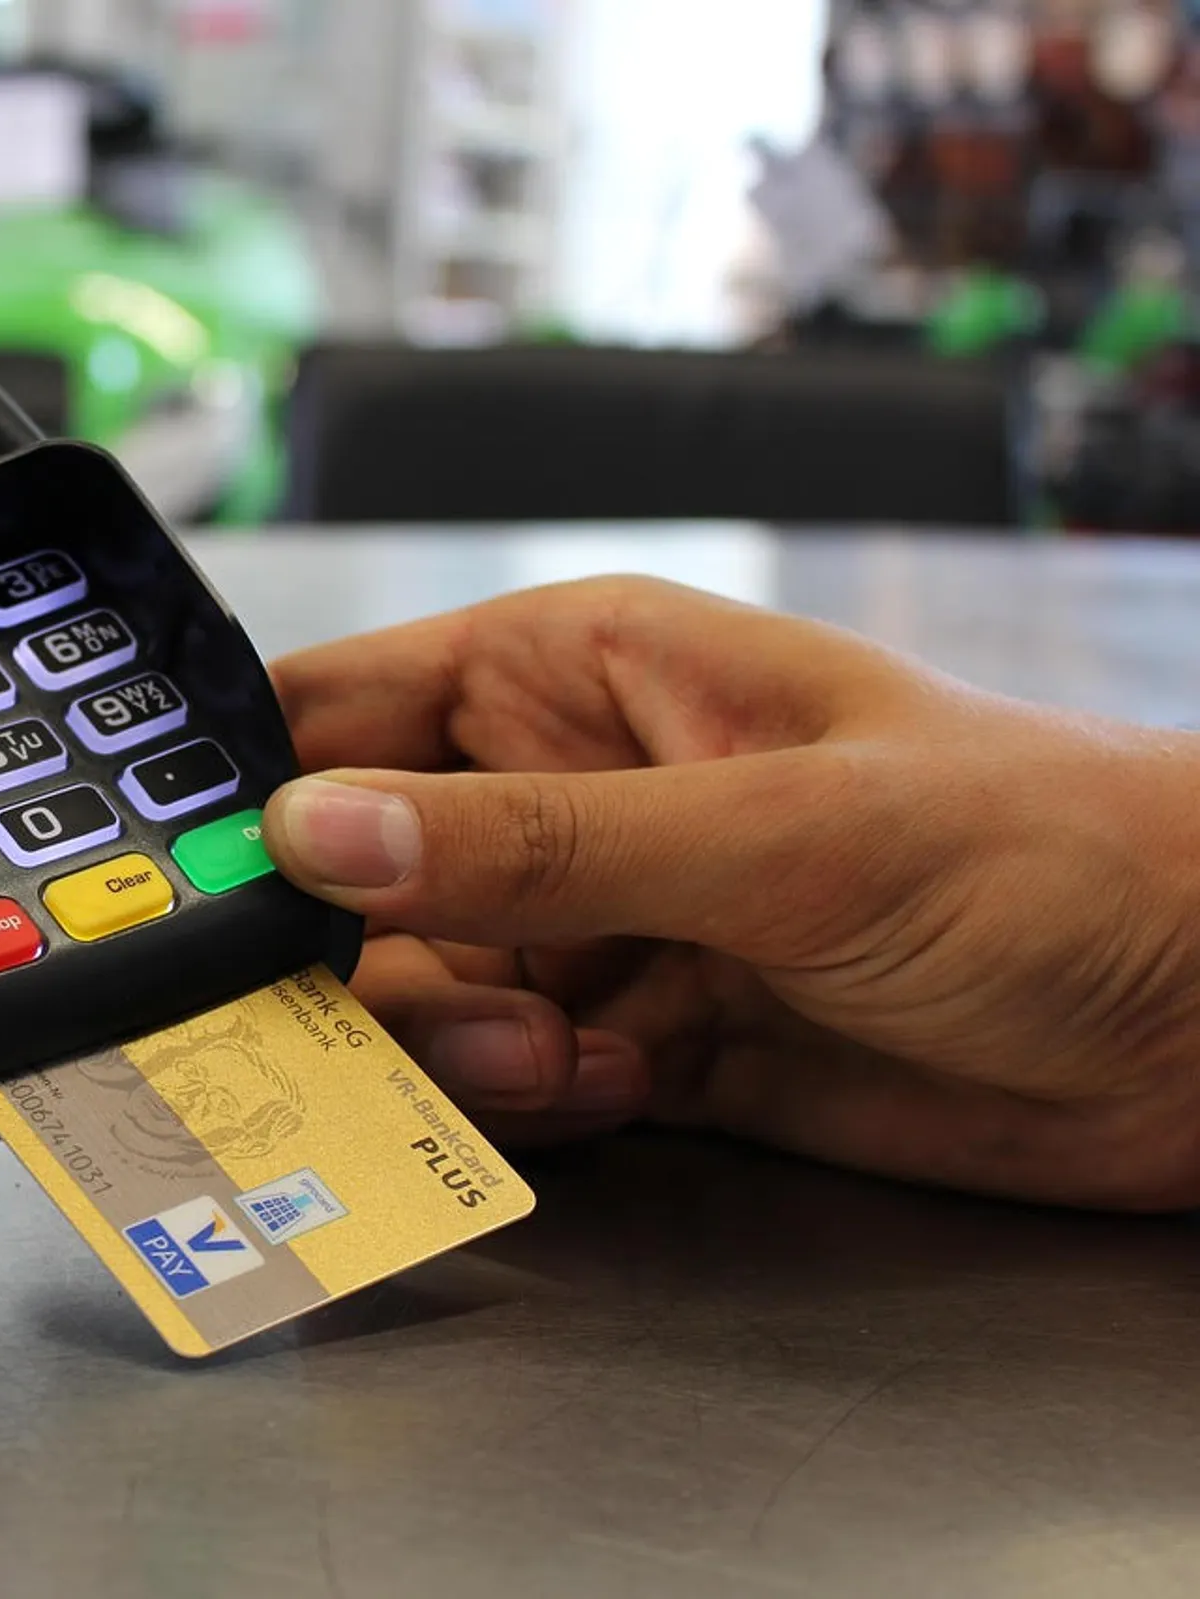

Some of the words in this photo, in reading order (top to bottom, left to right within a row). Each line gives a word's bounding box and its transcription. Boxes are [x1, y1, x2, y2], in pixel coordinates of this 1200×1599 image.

[43, 633, 83, 665] 6
[91, 696, 133, 727] 9
[20, 806, 63, 841] 0
[104, 870, 153, 895] Clear
[334, 1019, 372, 1048] eG
[386, 1067, 505, 1188] VR-BankCard
[410, 1136, 487, 1208] PLUS
[143, 1235, 194, 1277] PAY
